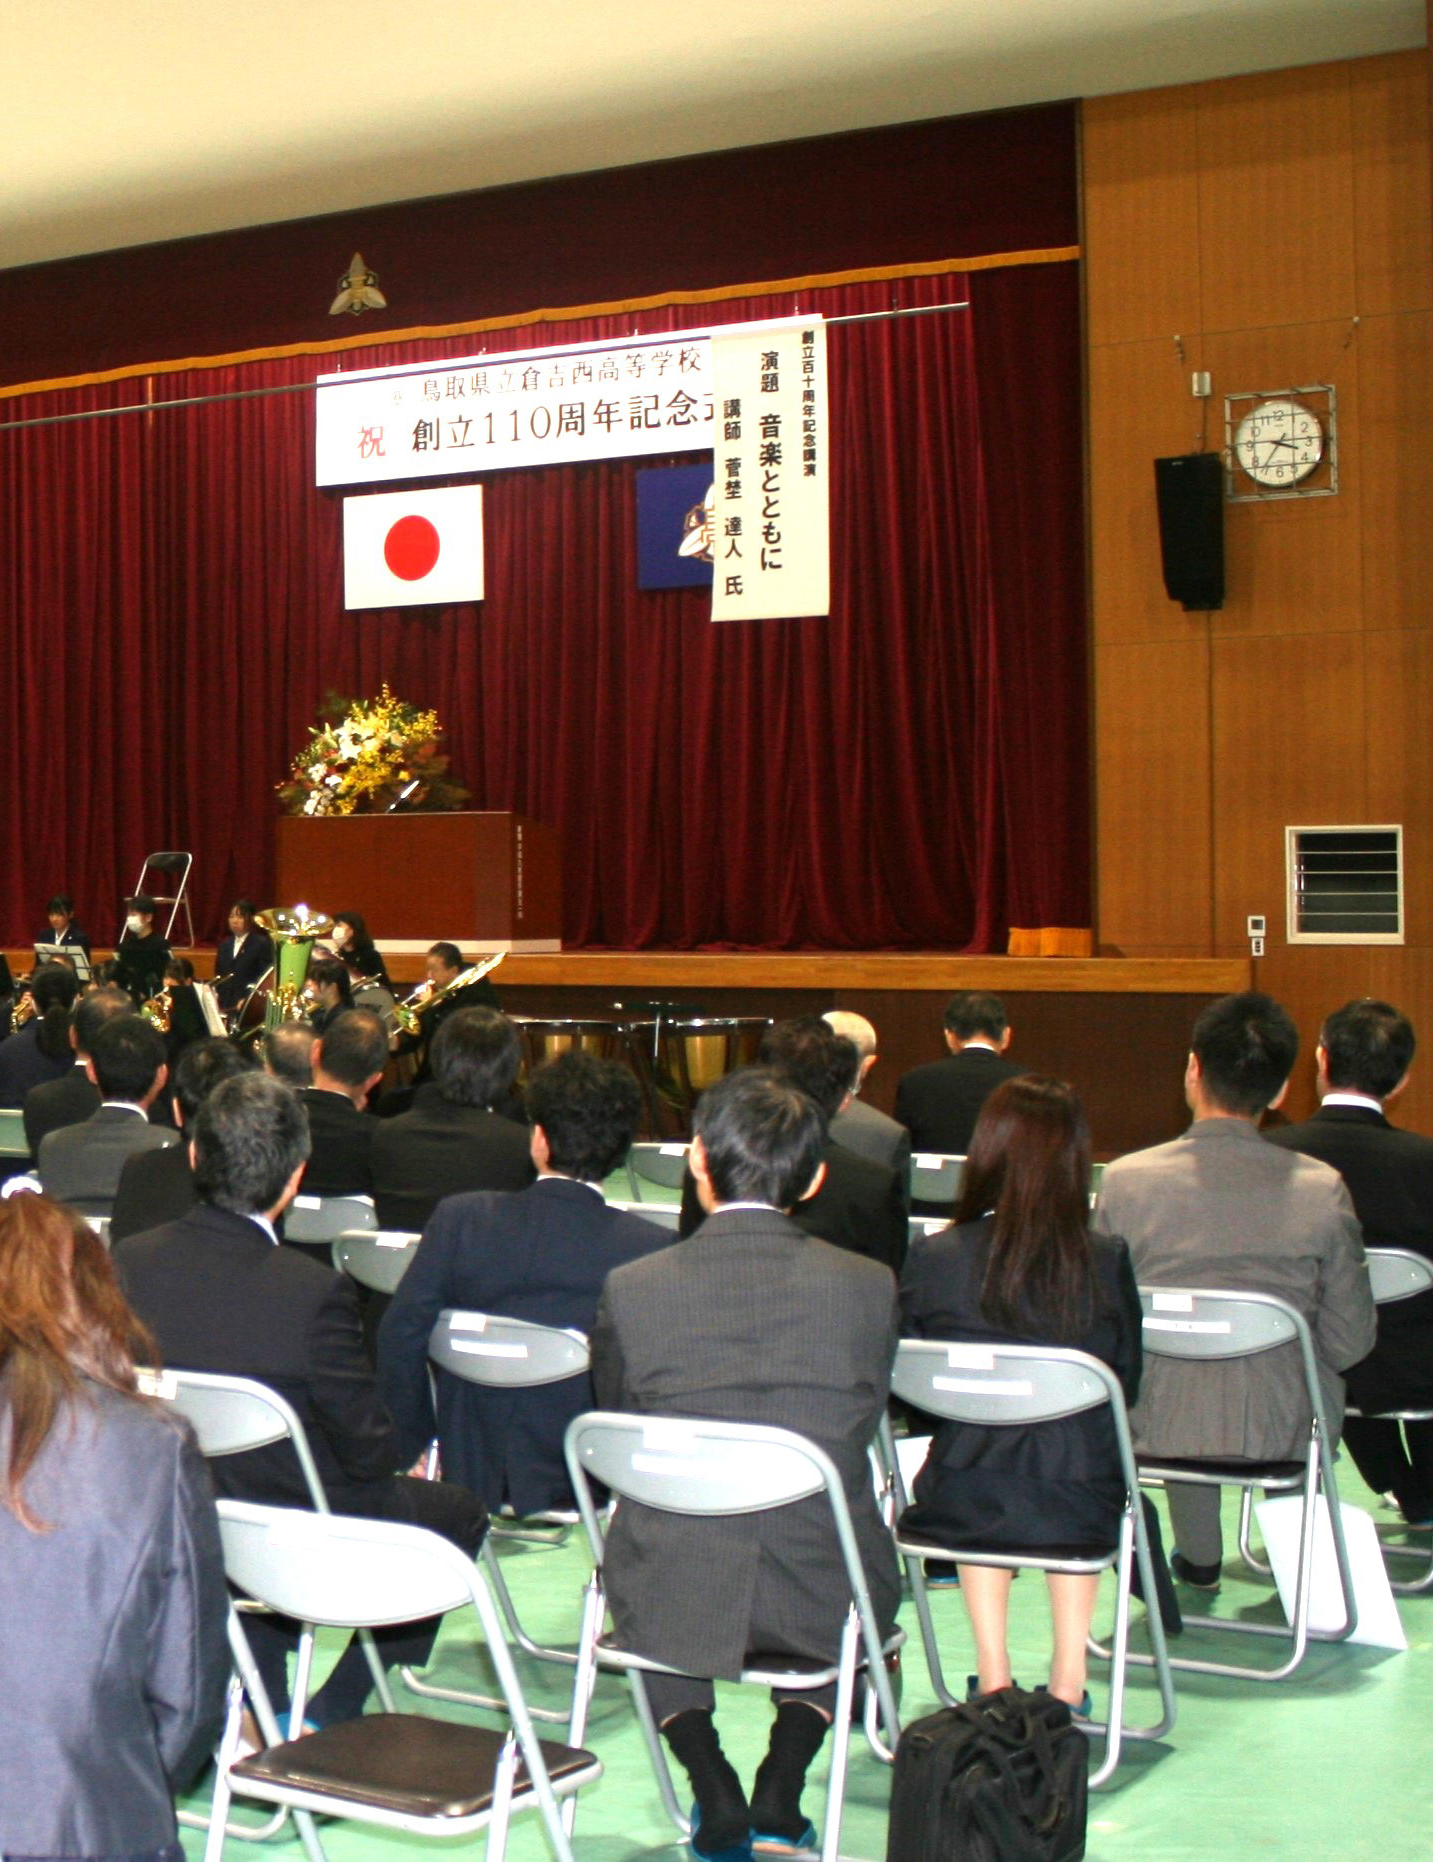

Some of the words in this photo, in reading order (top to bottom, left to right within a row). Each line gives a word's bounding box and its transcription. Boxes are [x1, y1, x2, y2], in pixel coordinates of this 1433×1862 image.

[421, 346, 702, 402] 鳥取県立倉吉西高等学校
[760, 350, 779, 393] 演題
[723, 398, 742, 442] 講師
[357, 425, 386, 459] 祝
[758, 413, 783, 572] 音楽とともに
[724, 516, 743, 559] 達人
[724, 575, 743, 597] 氏
